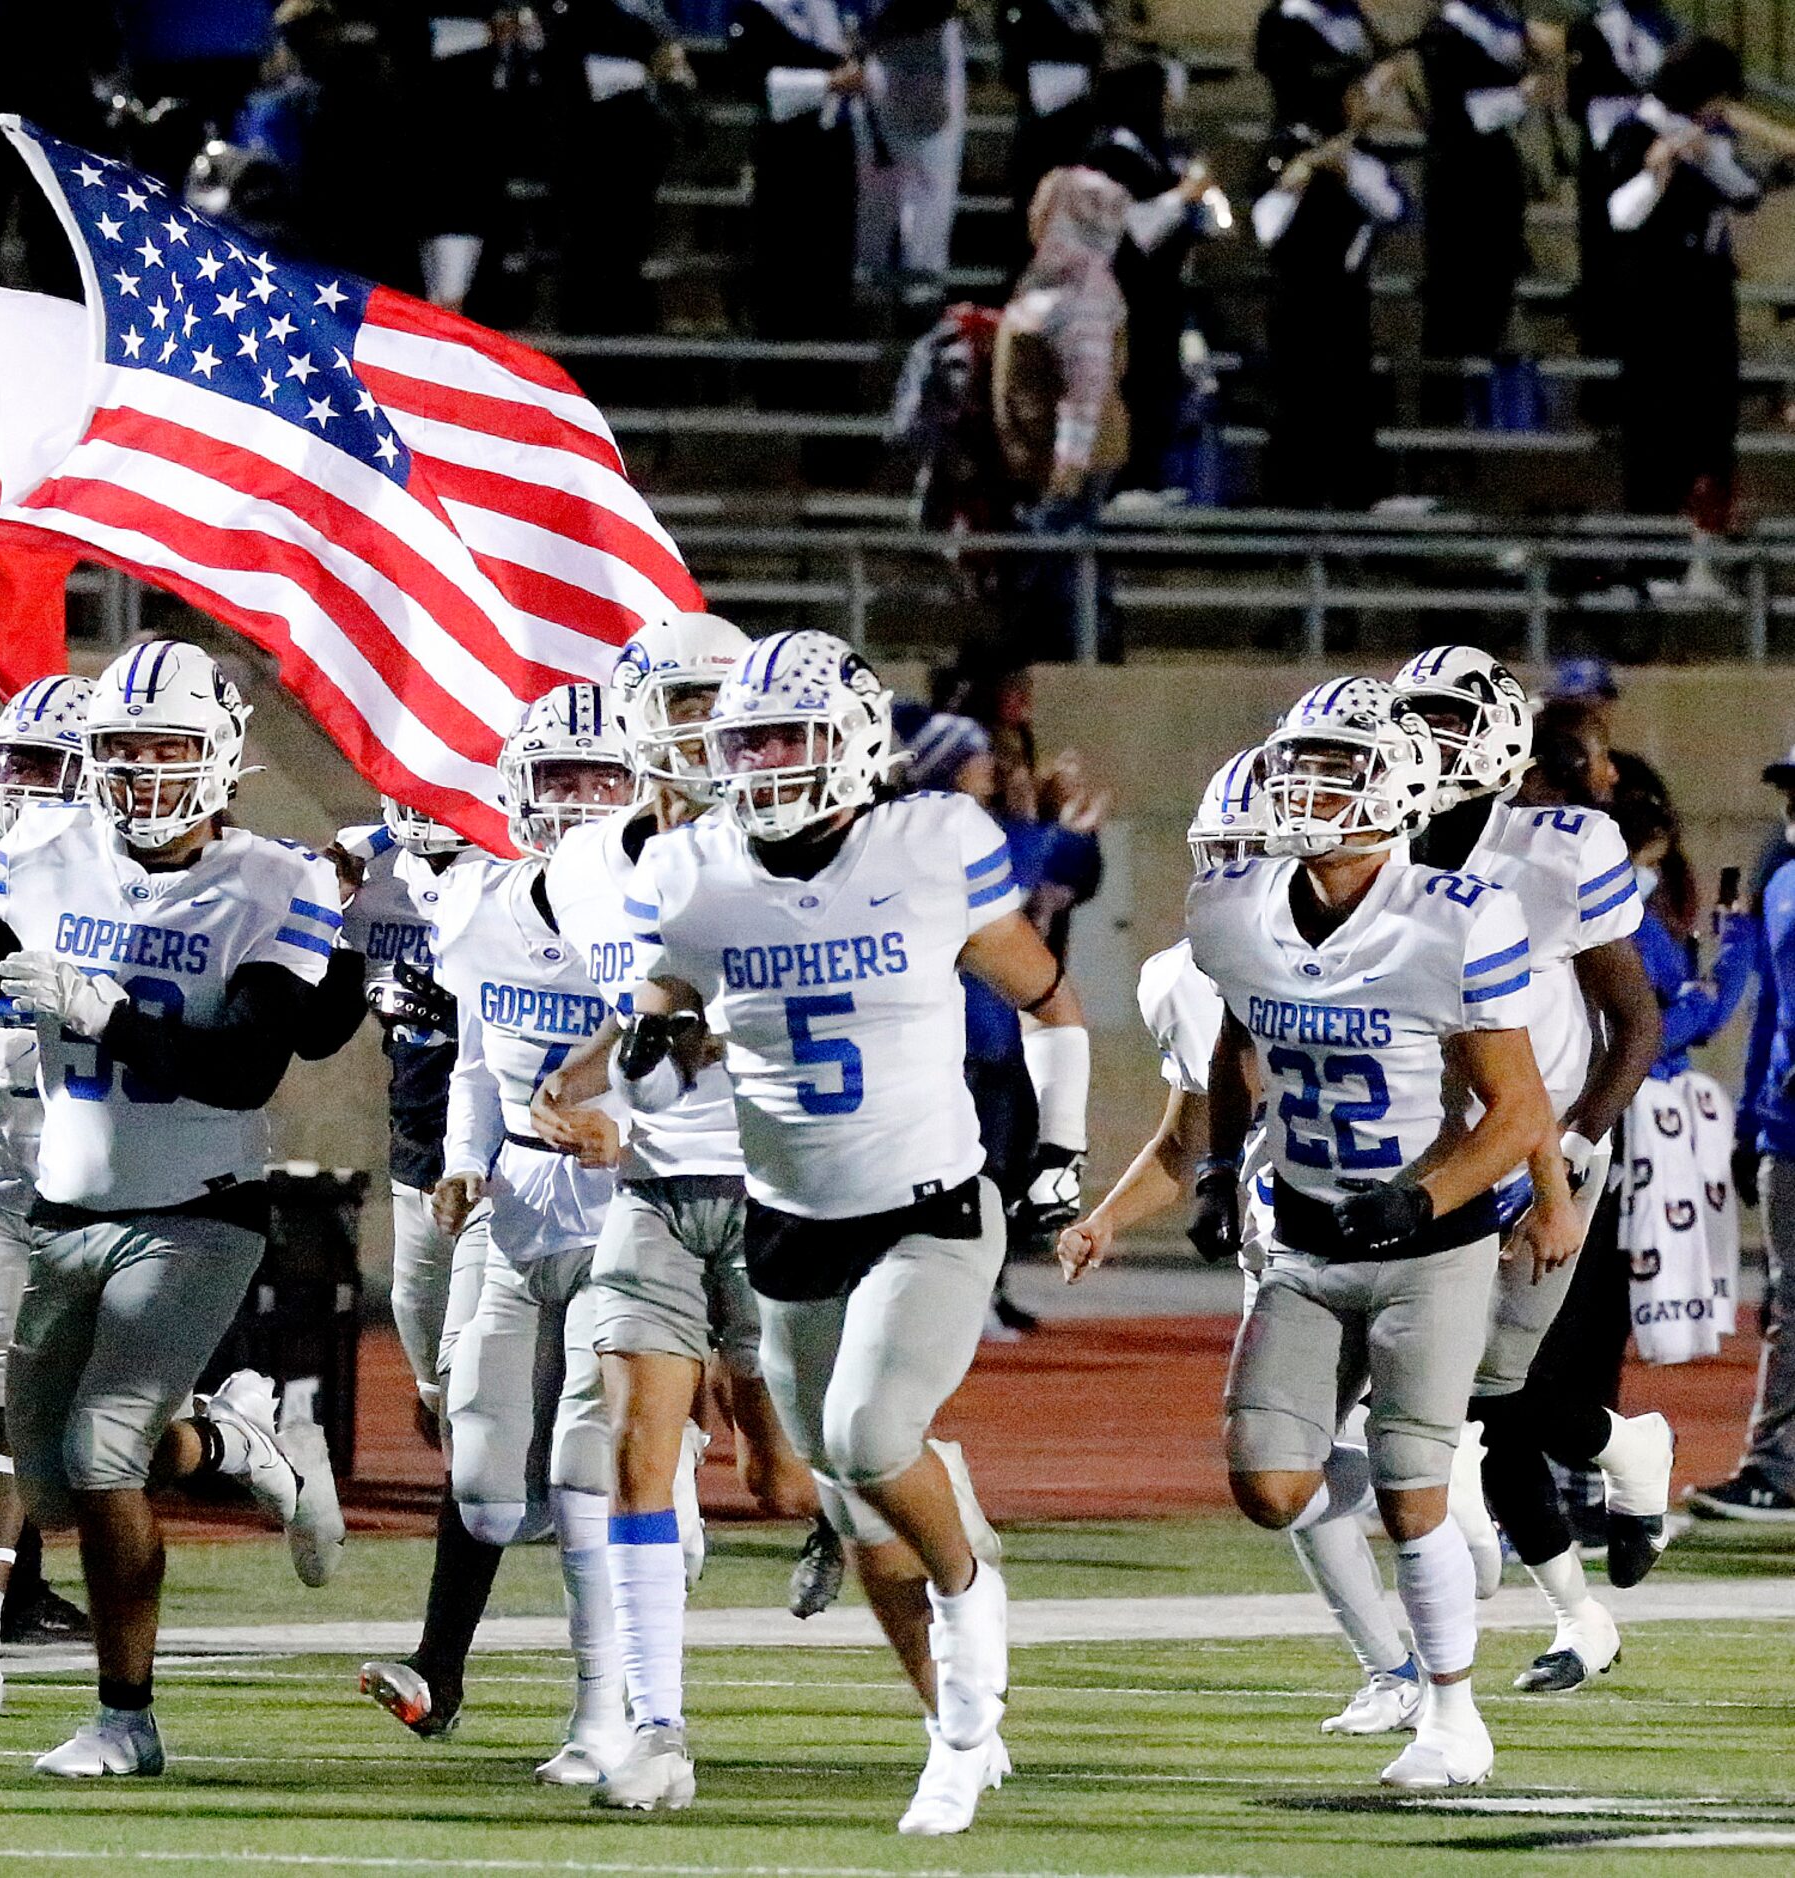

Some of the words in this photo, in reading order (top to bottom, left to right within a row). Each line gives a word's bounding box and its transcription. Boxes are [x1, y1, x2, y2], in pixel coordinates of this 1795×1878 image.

[55, 912, 210, 975] GOPHERS
[722, 931, 908, 990] GOPHERS
[480, 982, 607, 1036] GOPHER
[1248, 995, 1392, 1048] GOPHERS
[784, 992, 864, 1115] 5
[1267, 1045, 1403, 1170] 22
